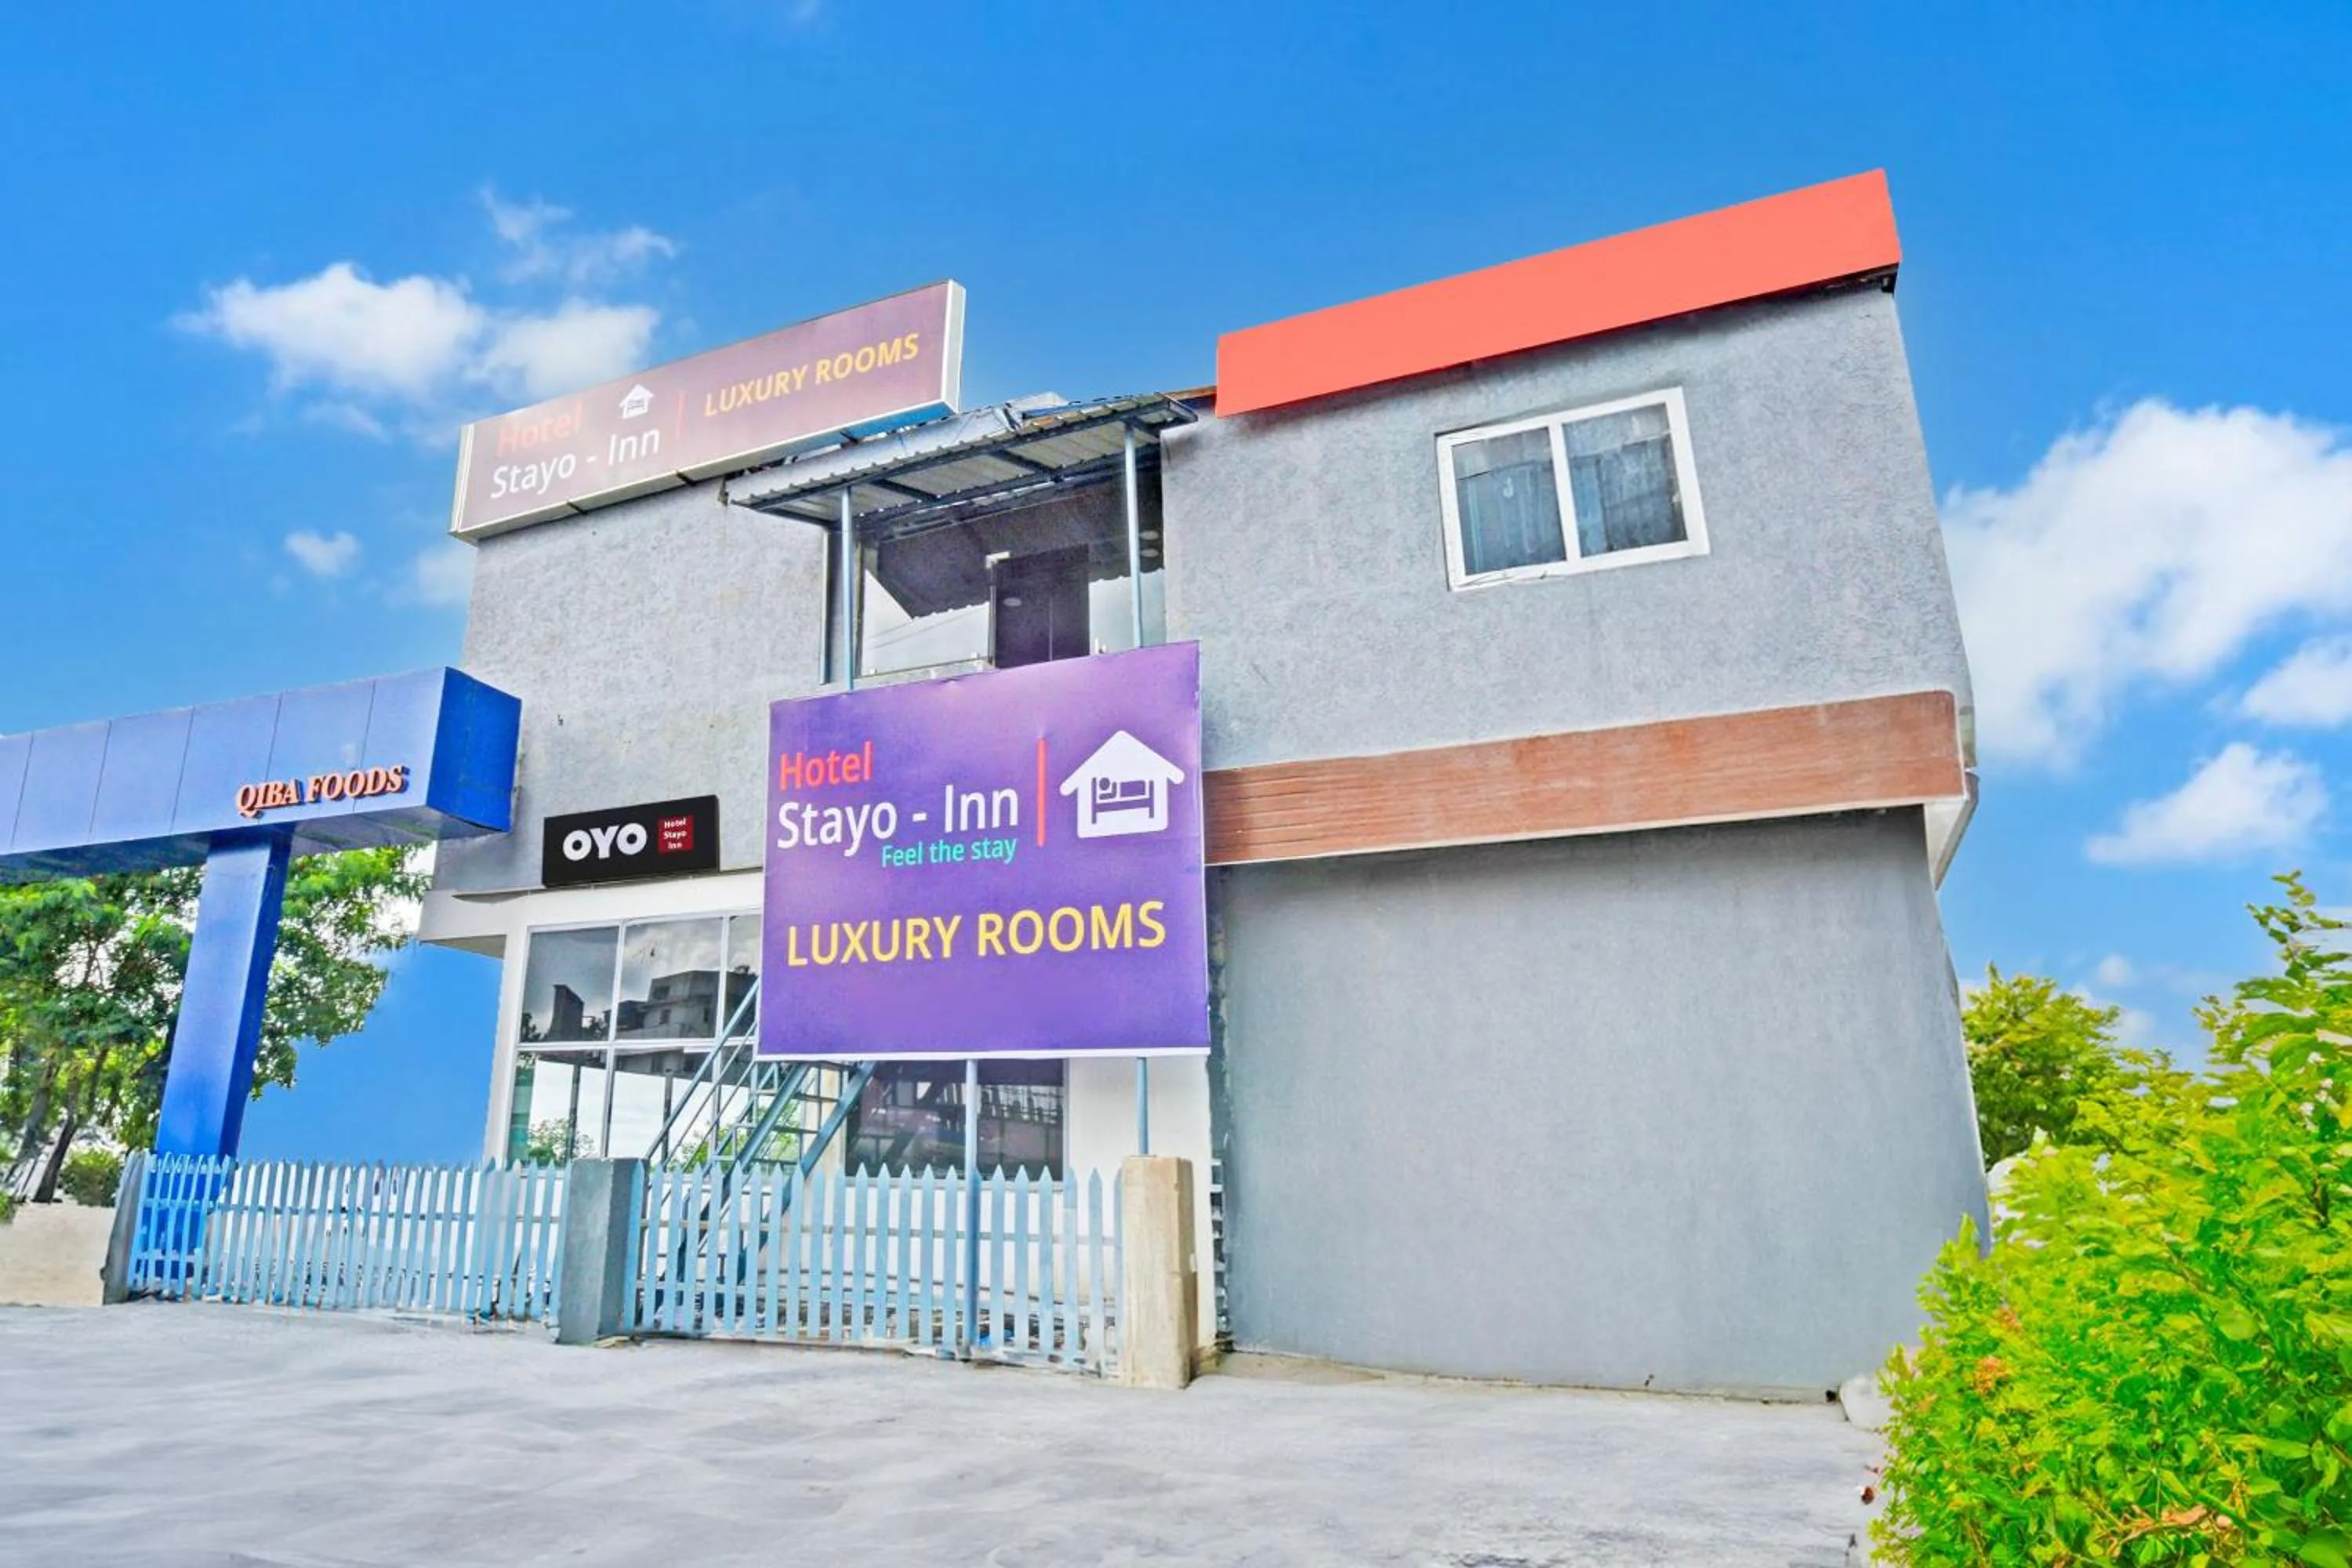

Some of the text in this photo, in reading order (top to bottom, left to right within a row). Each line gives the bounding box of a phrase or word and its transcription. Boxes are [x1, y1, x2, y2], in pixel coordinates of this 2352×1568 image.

[705, 332, 919, 417] LUXURY ROOMS
[495, 397, 583, 457] Hotel
[490, 453, 576, 499] Stayo
[608, 428, 660, 466] Inn
[236, 764, 408, 818] QIBA FOODS
[779, 741, 873, 791] Hotel
[562, 822, 648, 862] OYO
[662, 829, 687, 840] Stayo
[663, 817, 687, 829] Hotel
[776, 800, 898, 857] Stayo
[943, 784, 1019, 833] Inn
[881, 837, 1018, 867] Feel the stay
[786, 901, 1167, 968] LUXURY ROOMS
